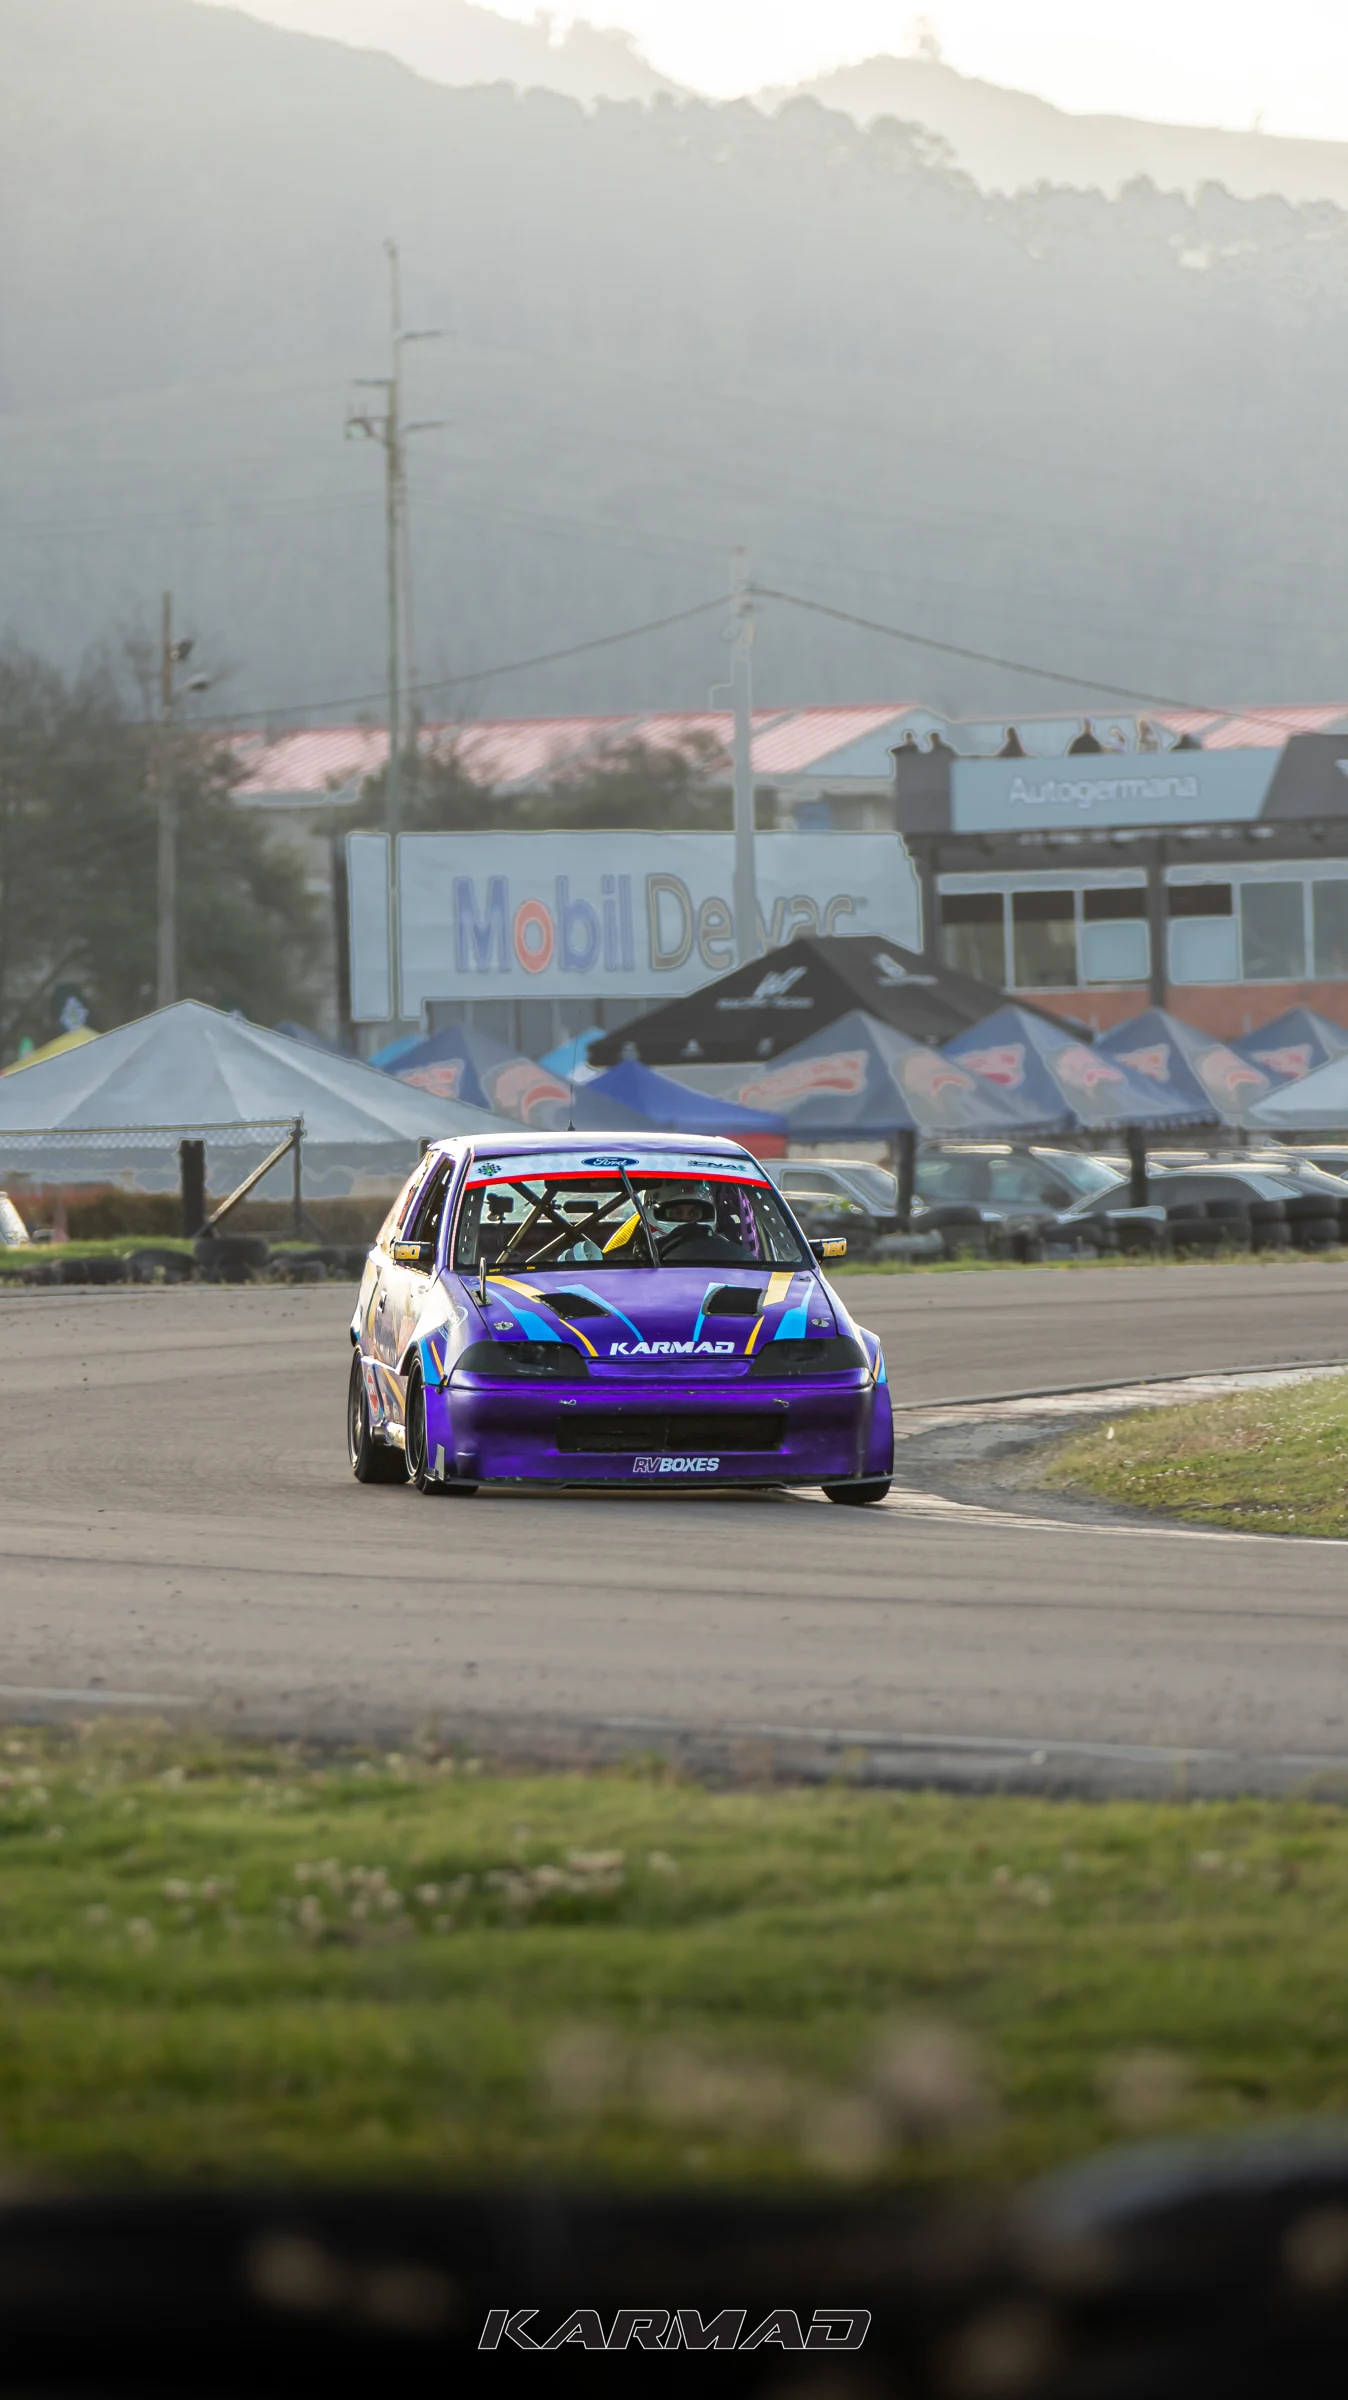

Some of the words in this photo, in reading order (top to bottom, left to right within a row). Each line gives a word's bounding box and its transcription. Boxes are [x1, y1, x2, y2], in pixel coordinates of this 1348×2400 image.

[1009, 776, 1198, 808] Autogermana
[453, 875, 635, 973] Mobil
[822, 1241, 847, 1257] 180
[610, 1342, 735, 1355] KARMAD
